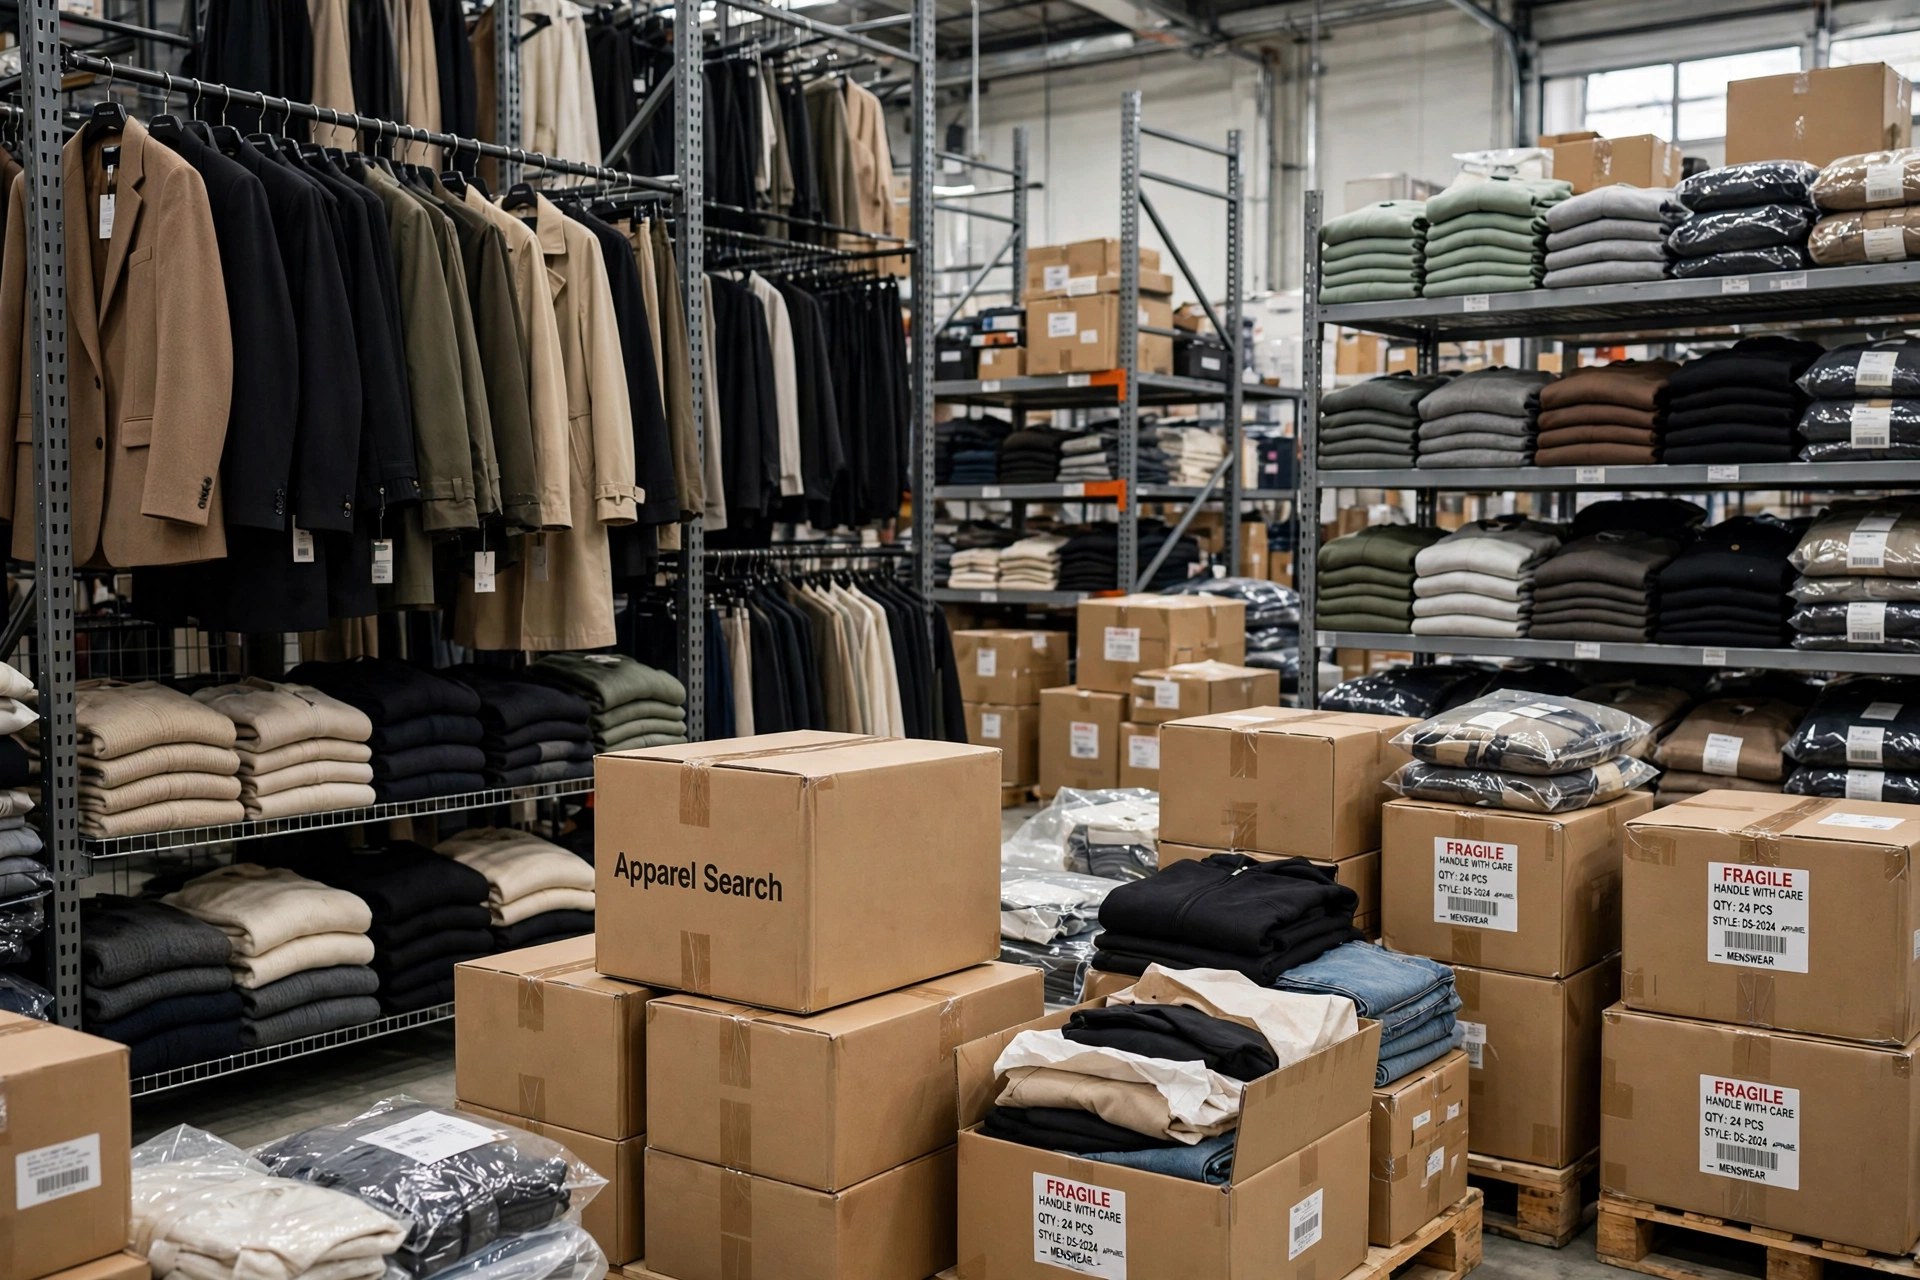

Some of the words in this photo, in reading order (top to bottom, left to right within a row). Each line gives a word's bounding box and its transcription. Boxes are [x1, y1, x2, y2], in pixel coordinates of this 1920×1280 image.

[1447, 842, 1504, 860] FRAGILE
[1440, 856, 1468, 867] HANDLE
[1472, 860, 1490, 869] WITH
[1492, 862, 1512, 871] CARE
[614, 852, 695, 890] Apparel
[704, 864, 782, 901] Search
[1724, 868, 1792, 887] FRAGILE
[1714, 884, 1750, 896] HANDLE
[1753, 887, 1775, 898] WITH
[1779, 890, 1803, 900] CARE
[1739, 903, 1750, 913] 24
[1754, 904, 1772, 915] PCS
[1450, 913, 1488, 924] MENSWEAR
[1743, 919, 1775, 931] DS-2024
[1727, 952, 1774, 965] MENSWEAR
[1715, 1081, 1783, 1105] FRAGILE
[1706, 1096, 1741, 1110] HANDLE
[1744, 1102, 1766, 1114] WITH
[1770, 1107, 1794, 1118] CARE
[1730, 1117, 1741, 1127] 24
[1745, 1119, 1763, 1131] PCS
[1734, 1132, 1767, 1147] DS-2024
[1719, 1163, 1765, 1180] MENSWEAR
[1047, 1180, 1110, 1208] FRAGILE
[1039, 1195, 1071, 1212] HANDLE
[1074, 1204, 1095, 1217] WITH
[1098, 1210, 1121, 1223] CARE
[1062, 1219, 1072, 1229] 24
[1076, 1222, 1094, 1236] PCS
